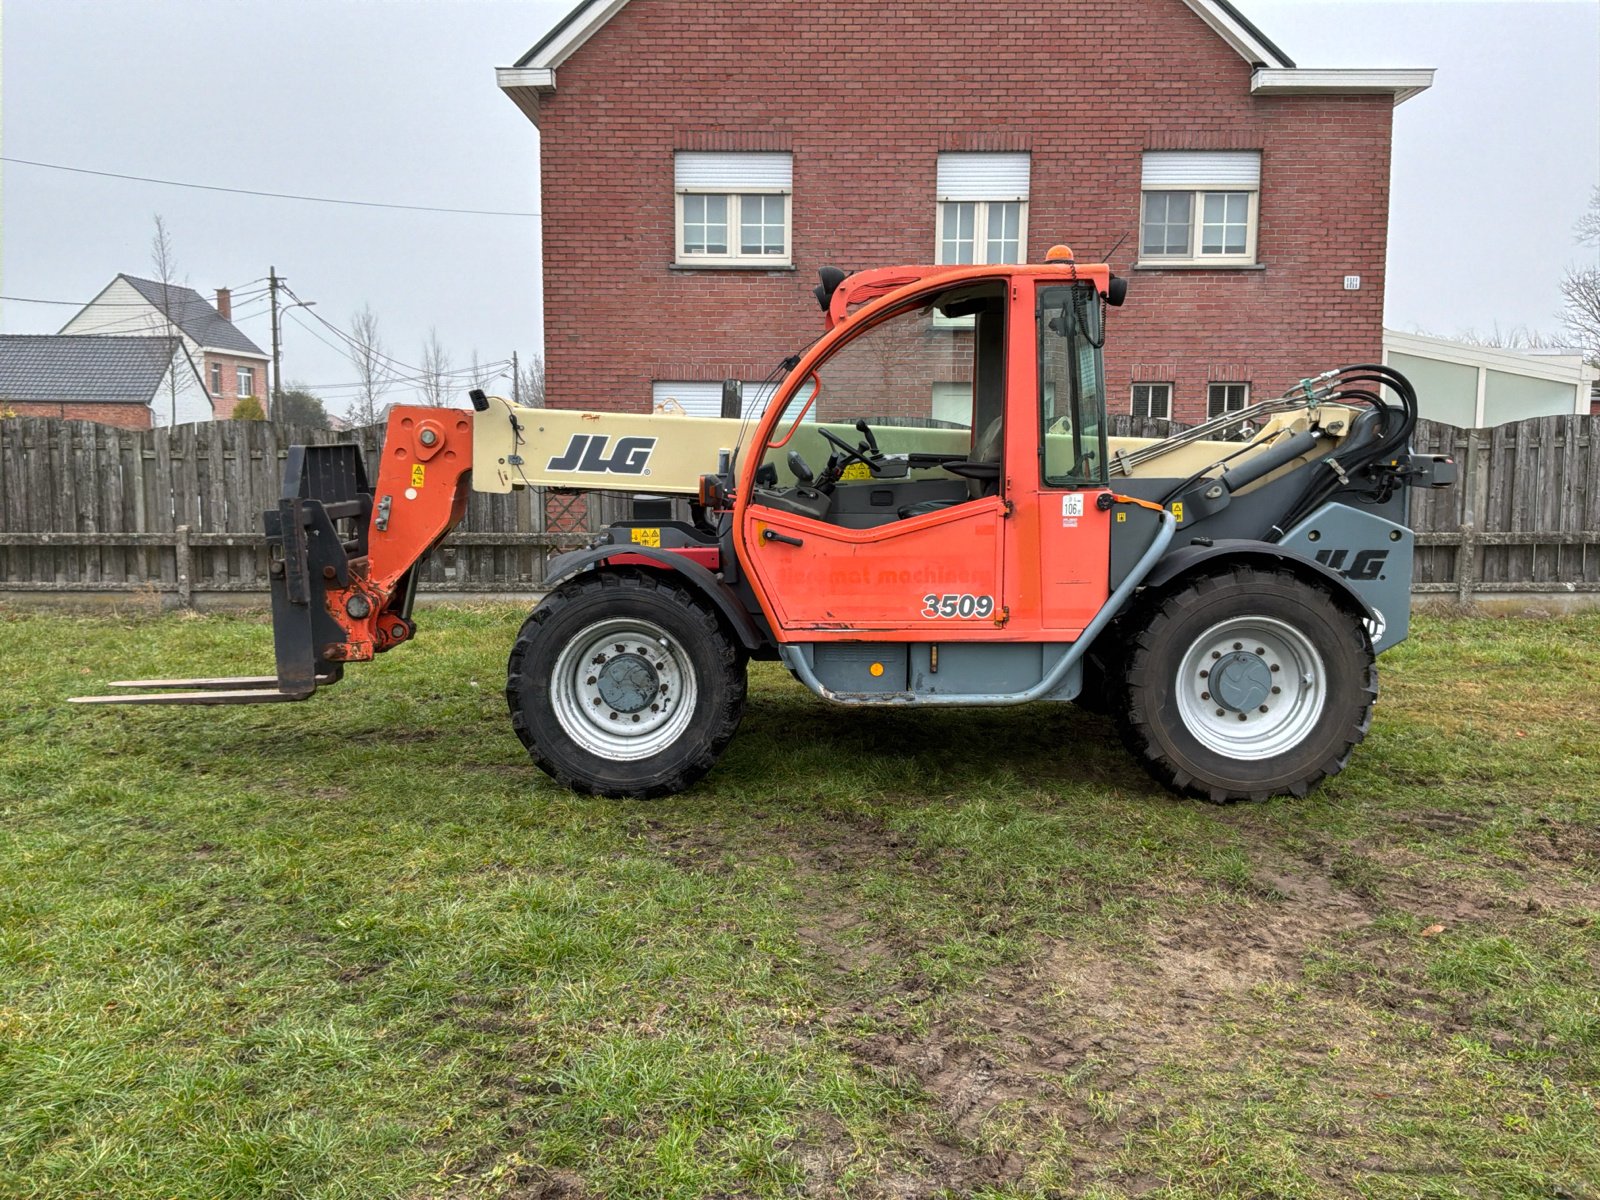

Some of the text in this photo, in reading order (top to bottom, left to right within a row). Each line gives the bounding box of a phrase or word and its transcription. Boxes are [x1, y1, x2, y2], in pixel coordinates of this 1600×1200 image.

[545, 433, 659, 476] JLG
[1064, 503, 1078, 515] 106
[921, 594, 994, 619] 3509
